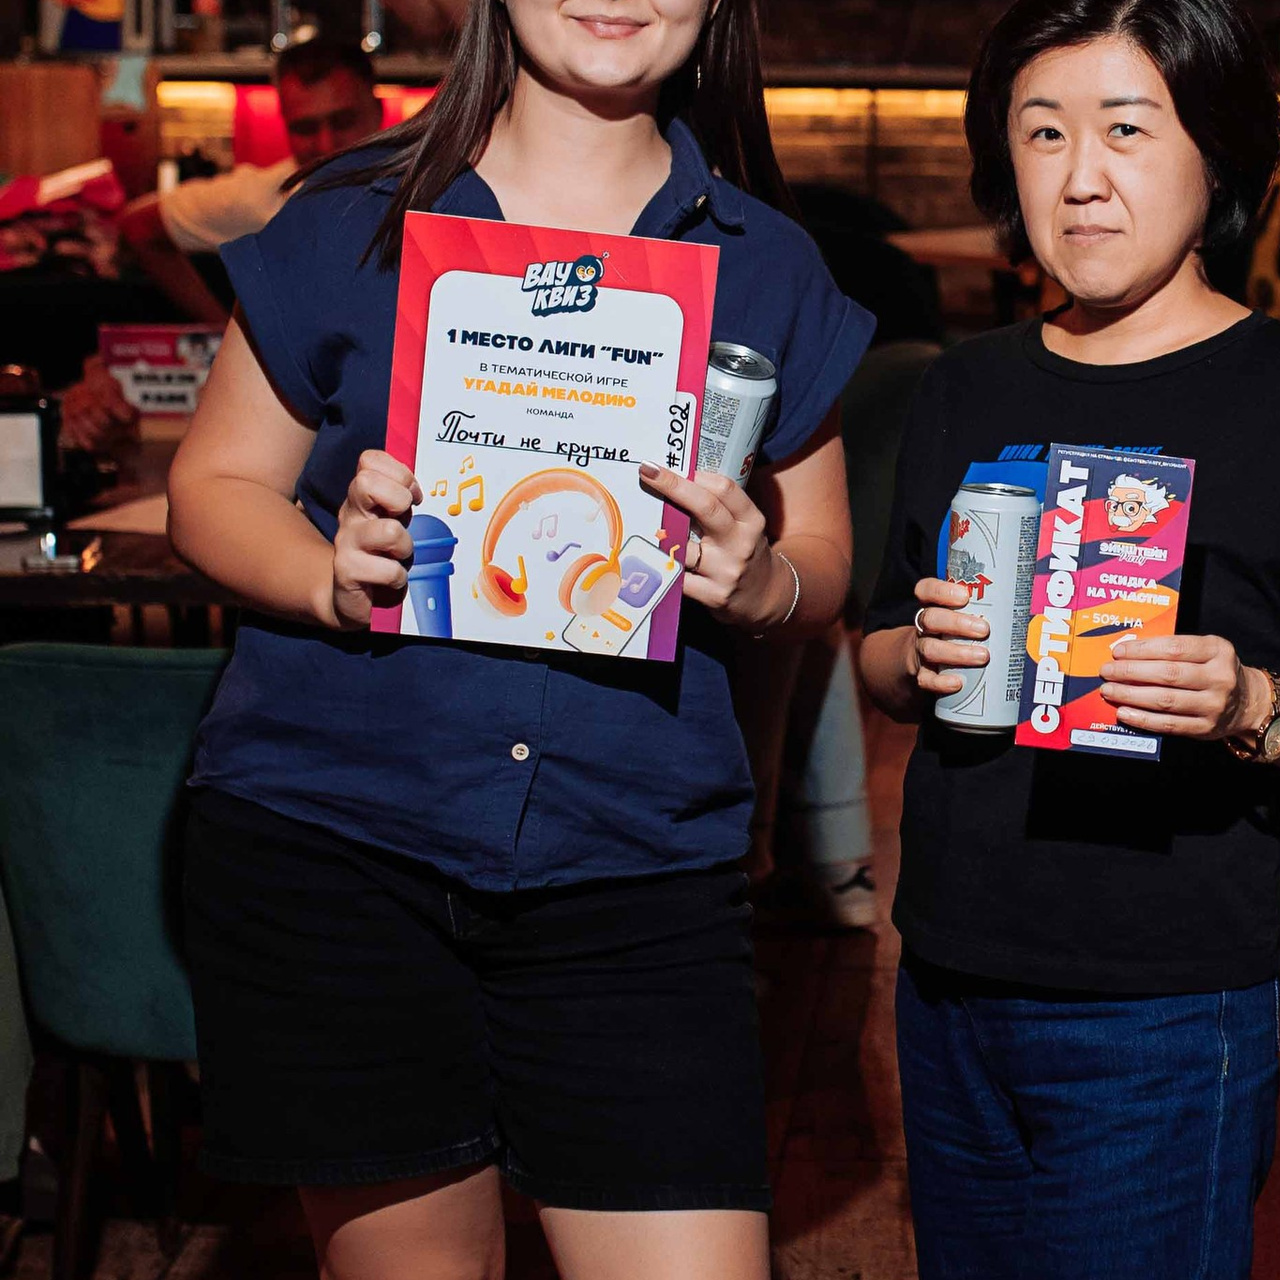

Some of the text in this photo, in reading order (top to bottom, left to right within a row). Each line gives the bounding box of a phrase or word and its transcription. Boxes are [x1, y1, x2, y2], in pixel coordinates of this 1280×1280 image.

[523, 261, 573, 289] ВАУ
[533, 285, 592, 311] КВИЗ
[447, 329, 456, 343] 1
[461, 330, 534, 352] МЕСТО
[538, 339, 595, 359] ЛИГИ
[480, 363, 628, 388] В ТЕМАТИЧЕСКОЙ ИГРЕ
[464, 377, 636, 408] УГАДАЙ МЕЛОДИЮ
[526, 408, 574, 419] КОМАНДА
[437, 410, 630, 467] Почти не крутые
[666, 401, 690, 468] #502
[1100, 542, 1168, 560] ЭЙНШТЕЙН
[1099, 573, 1158, 589] СКИДКА
[1031, 460, 1089, 733] СЕРТИФИКАТ
[1087, 586, 1170, 606] НА УЧАСТИЕ
[1093, 612, 1120, 626] 50%
[1124, 616, 1143, 629] НА
